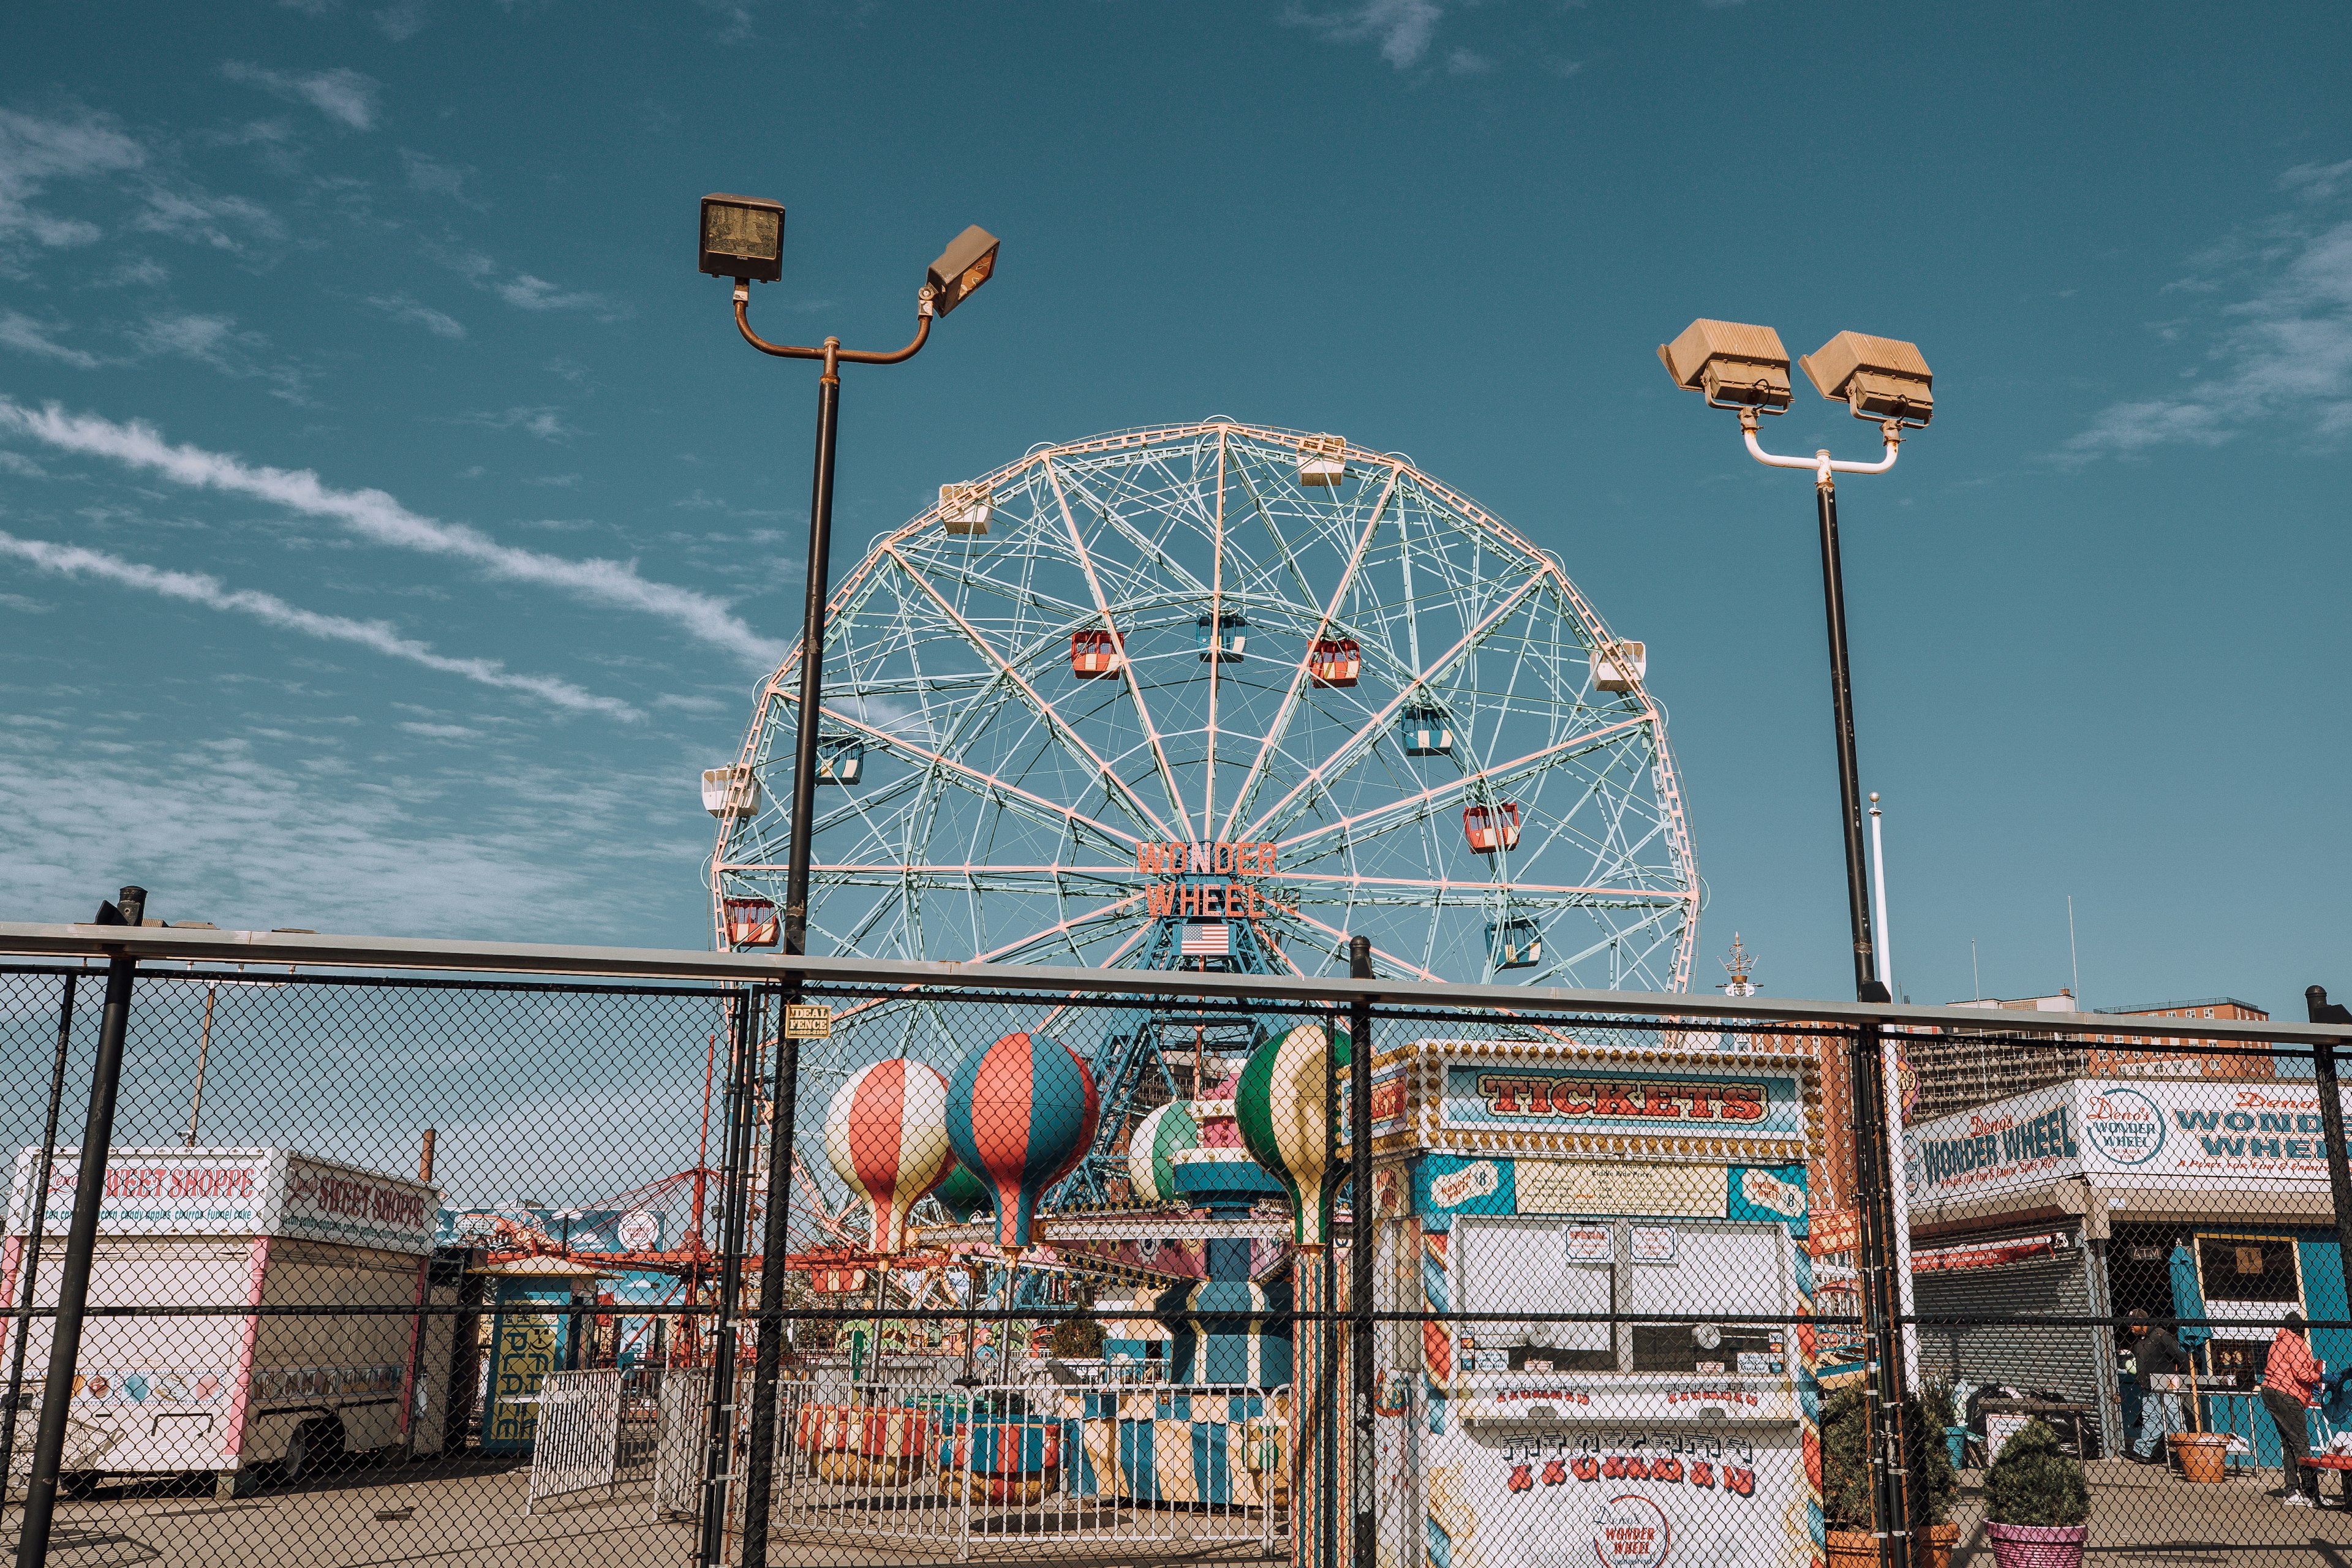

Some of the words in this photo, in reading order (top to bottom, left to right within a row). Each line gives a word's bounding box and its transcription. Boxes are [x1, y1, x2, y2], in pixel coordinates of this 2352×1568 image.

[1136, 842, 1277, 875] WONDER
[1145, 881, 1268, 917] WHEEL
[790, 1009, 827, 1018] IDEAL
[790, 1019, 827, 1029] FENCE
[1485, 1079, 1763, 1120] TICKETS
[2087, 1097, 2150, 1120] Deno's
[1970, 1114, 2013, 1137] Deno's
[2095, 1122, 2156, 1134] WONDER
[1921, 1134, 1999, 1186] WONDER
[2002, 1104, 2077, 1163] WHEEL
[2103, 1136, 2151, 1147] WHEEL
[48, 1161, 78, 1194] Deno
[105, 1167, 168, 1198] WEET
[170, 1167, 256, 1198] SHOPPE
[1442, 1173, 1471, 1194] WONDER
[1752, 1182, 1779, 1193] WONDER
[318, 1174, 372, 1218] SWEET
[372, 1186, 424, 1228] SHOPPE
[1758, 1189, 1779, 1200] WHEEL
[121, 1209, 145, 1220] candy
[146, 1209, 171, 1221] apples
[175, 1208, 203, 1219] churros
[207, 1208, 232, 1219] funnel
[234, 1209, 252, 1219] cake
[1569, 1231, 1607, 1240] SPECIAL
[2133, 1248, 2160, 1259] ATM
[1496, 1381, 1590, 1405] TICKETS
[1665, 1382, 1758, 1406] TICKETS
[1500, 1429, 1756, 1498] TICKETS
[1593, 1506, 1640, 1525] Deno's
[1605, 1528, 1655, 1540] WONDER
[1614, 1542, 1650, 1555] WHEEL
